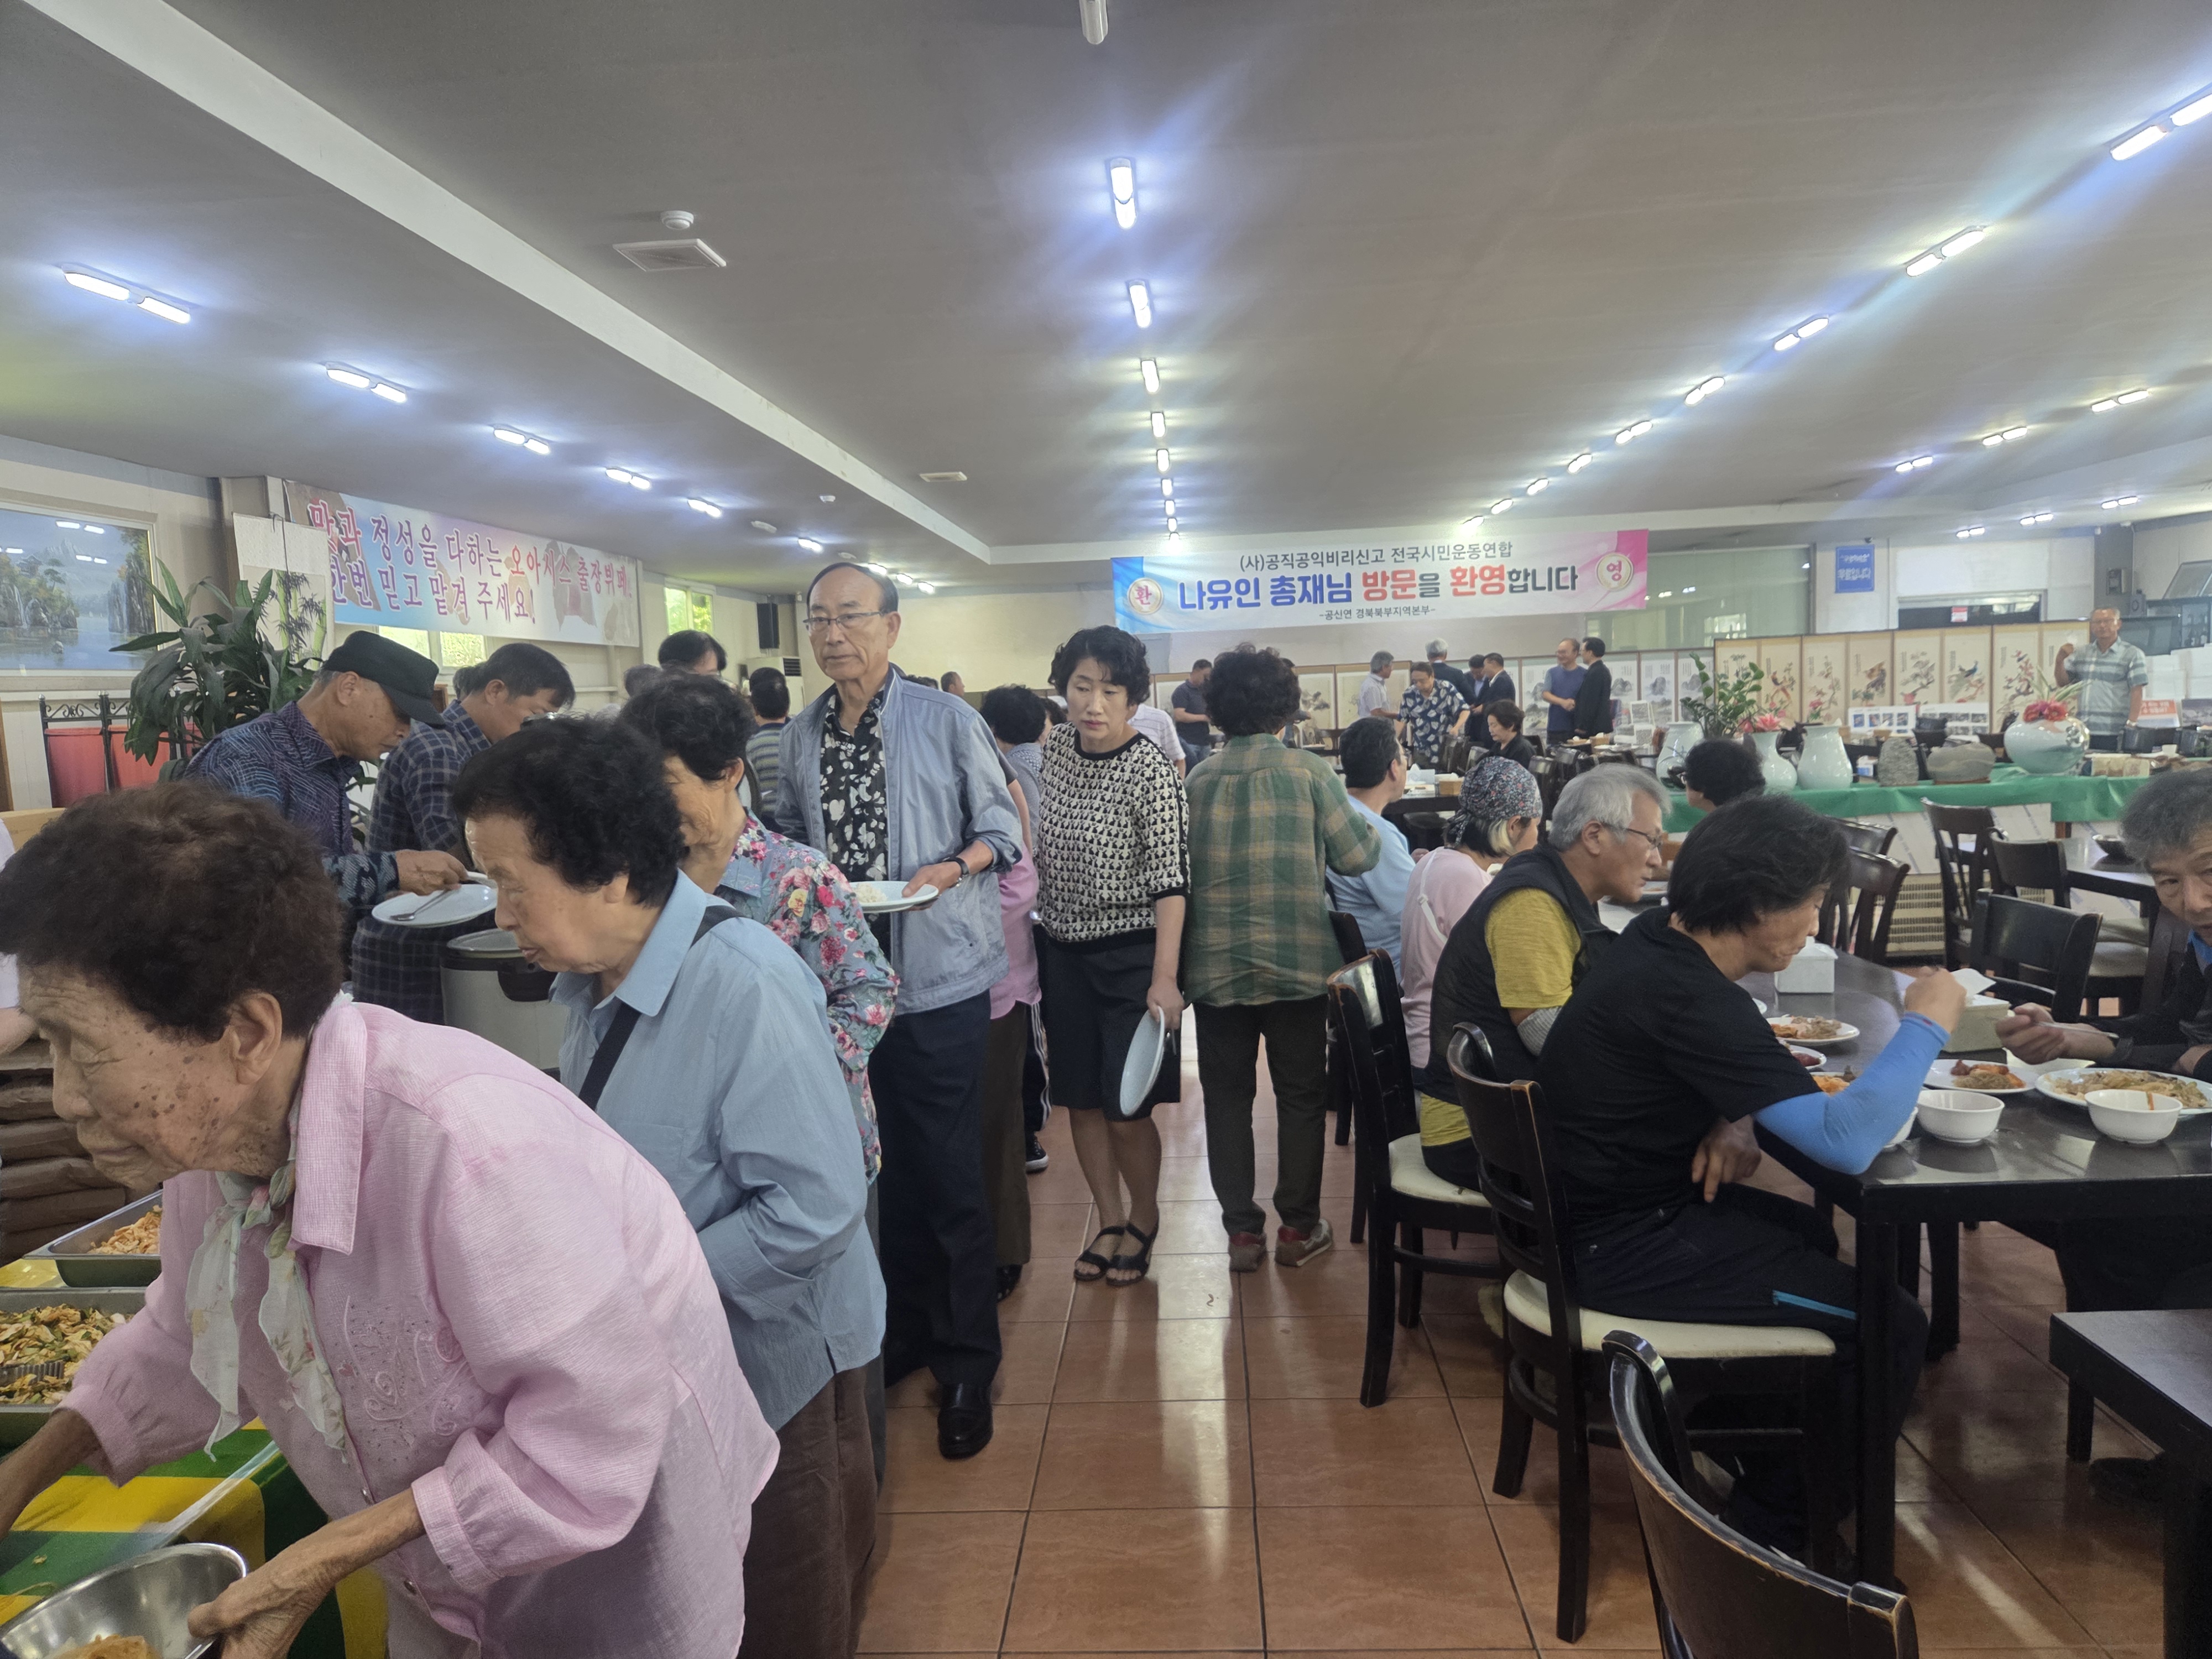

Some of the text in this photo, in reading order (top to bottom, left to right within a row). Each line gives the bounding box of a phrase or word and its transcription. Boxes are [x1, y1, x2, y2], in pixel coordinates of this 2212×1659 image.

[371, 514, 437, 568] 정성을
[445, 529, 503, 577] 다하는
[510, 544, 572, 587] 오아시스
[1240, 541, 1513, 572] (사)공직공익비리신고 전국시민운동연합
[1179, 564, 1578, 611] 나유인 총재님 방문을 환영합니다
[1606, 560, 1623, 581] 영
[378, 565, 422, 610] 믿고
[428, 573, 468, 619] 맡겨
[477, 581, 535, 624] 주세요!
[1134, 585, 1152, 606] 환
